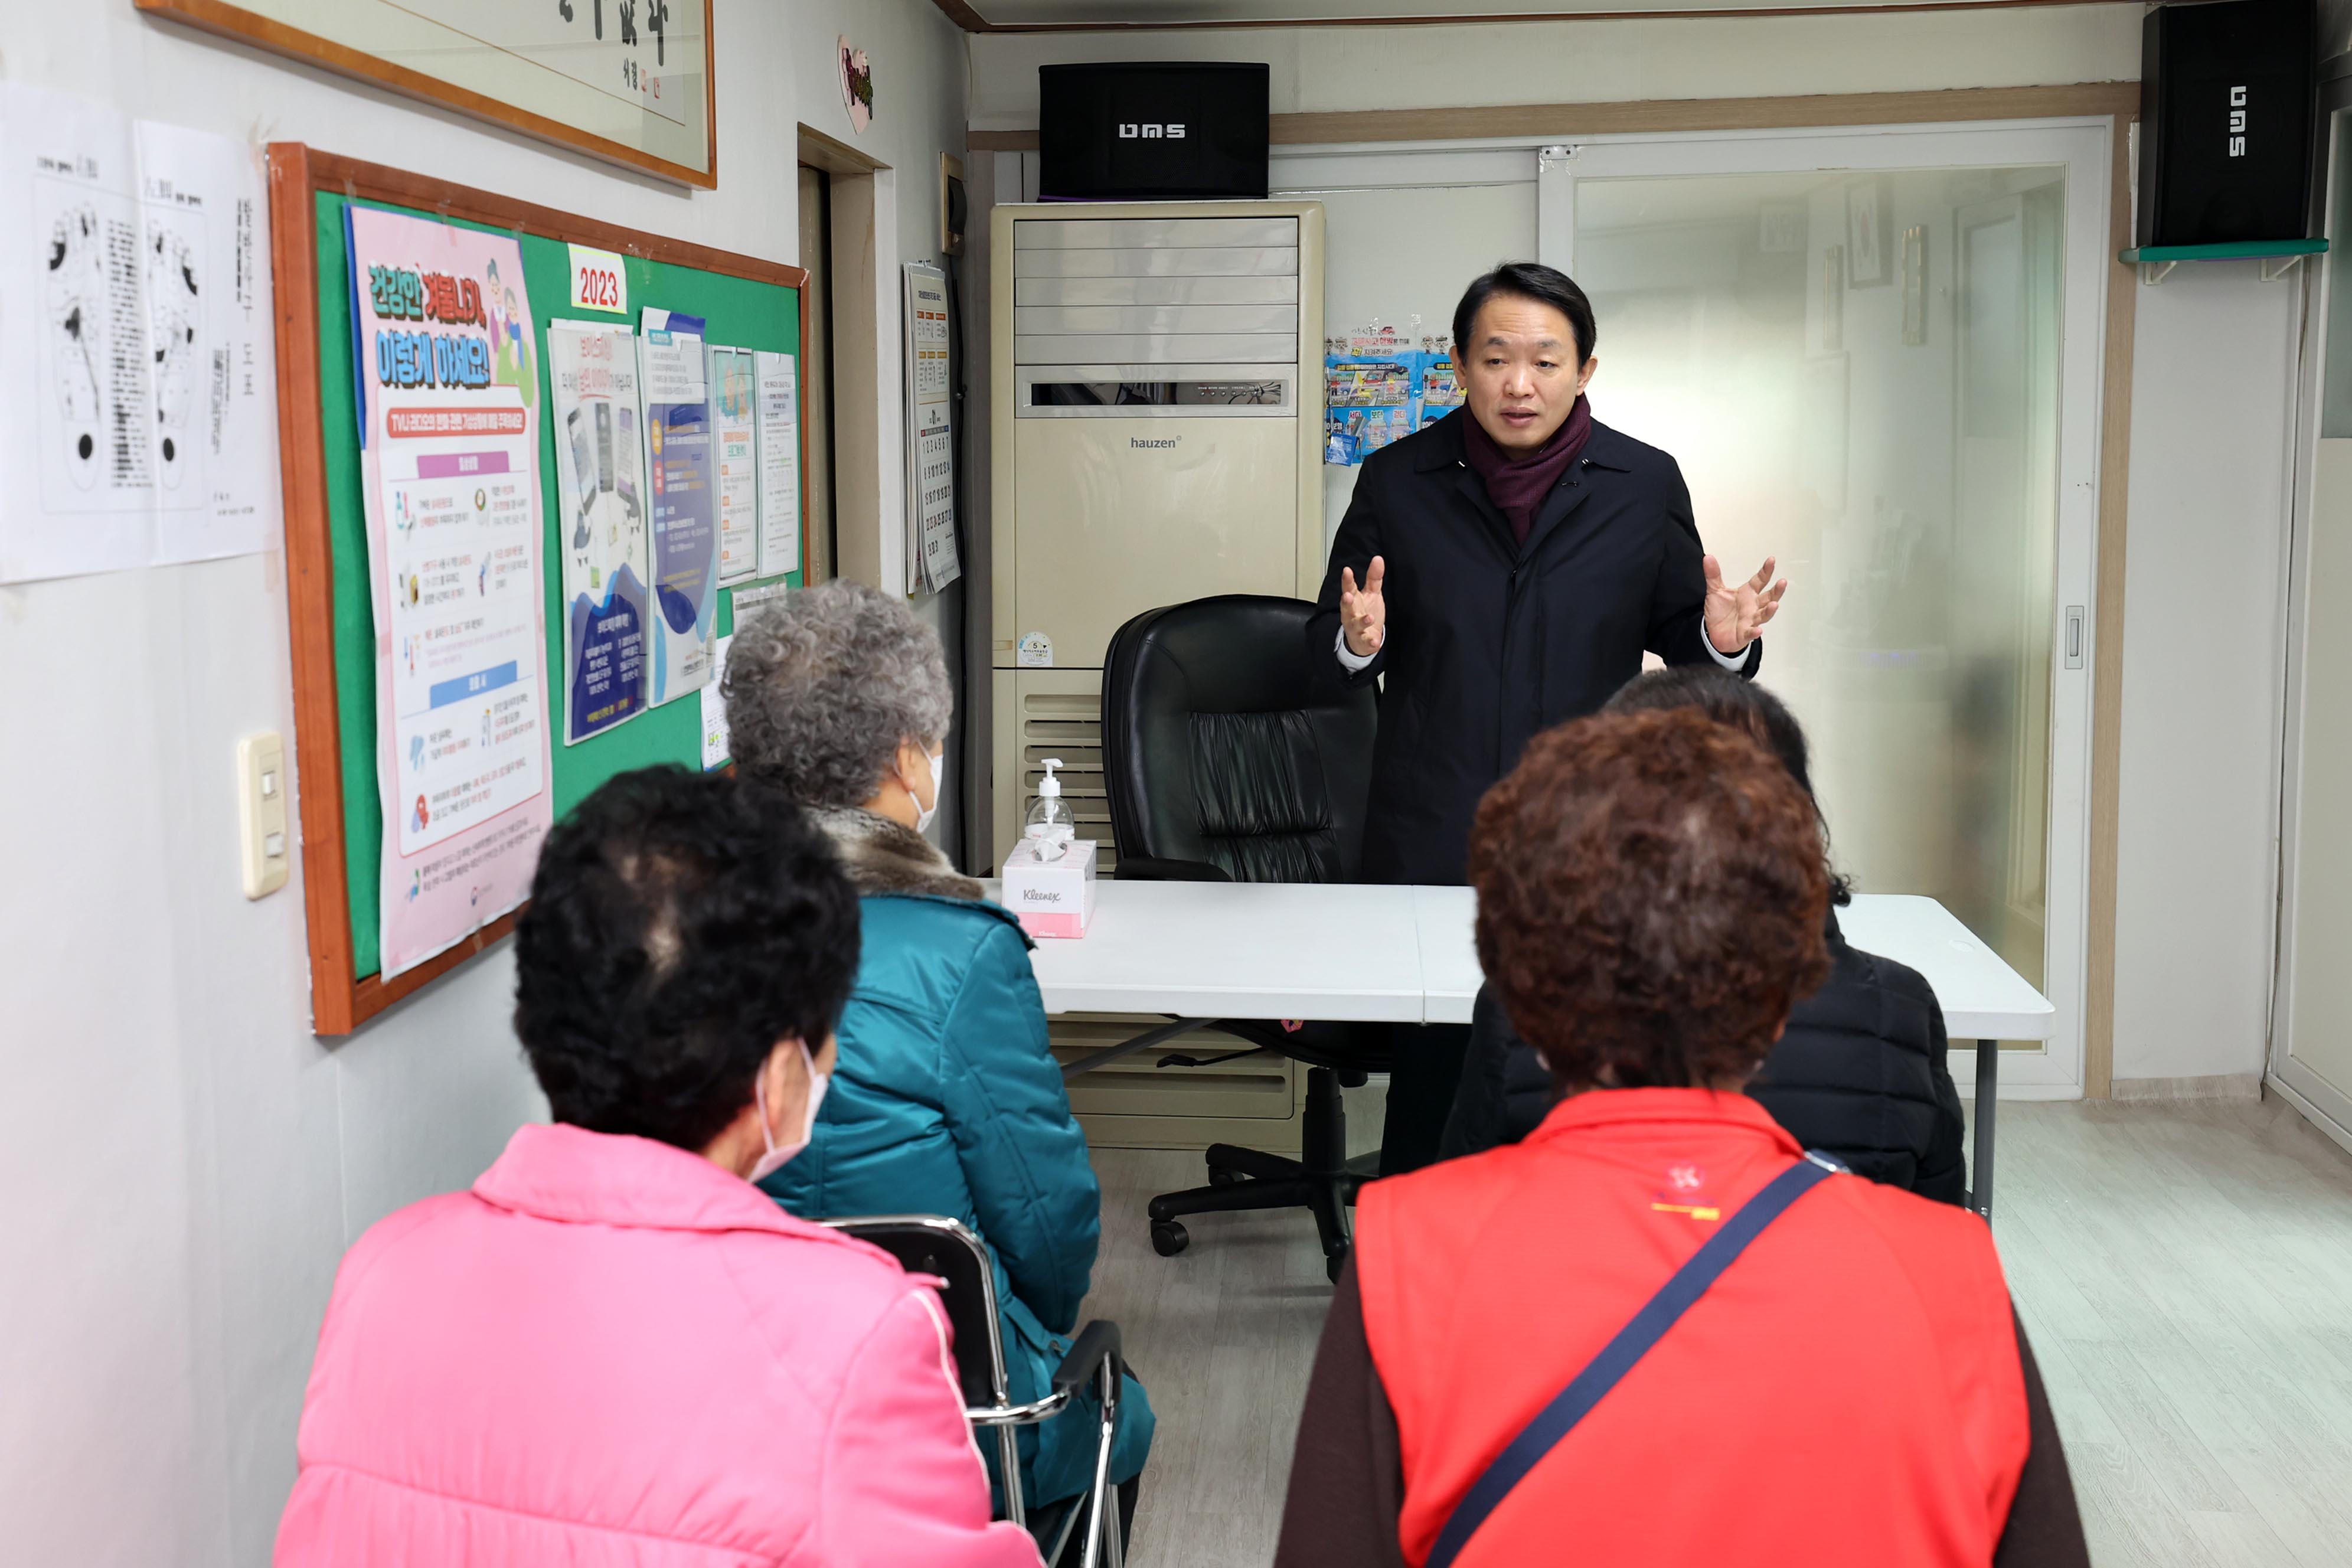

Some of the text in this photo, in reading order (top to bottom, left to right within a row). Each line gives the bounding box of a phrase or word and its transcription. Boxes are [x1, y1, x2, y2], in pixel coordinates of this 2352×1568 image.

[368, 264, 424, 322] 건강한
[580, 267, 618, 307] 2023
[376, 328, 436, 390] 이렇게
[1131, 437, 1175, 447] hauzen
[1024, 888, 1061, 903] Kleenex
